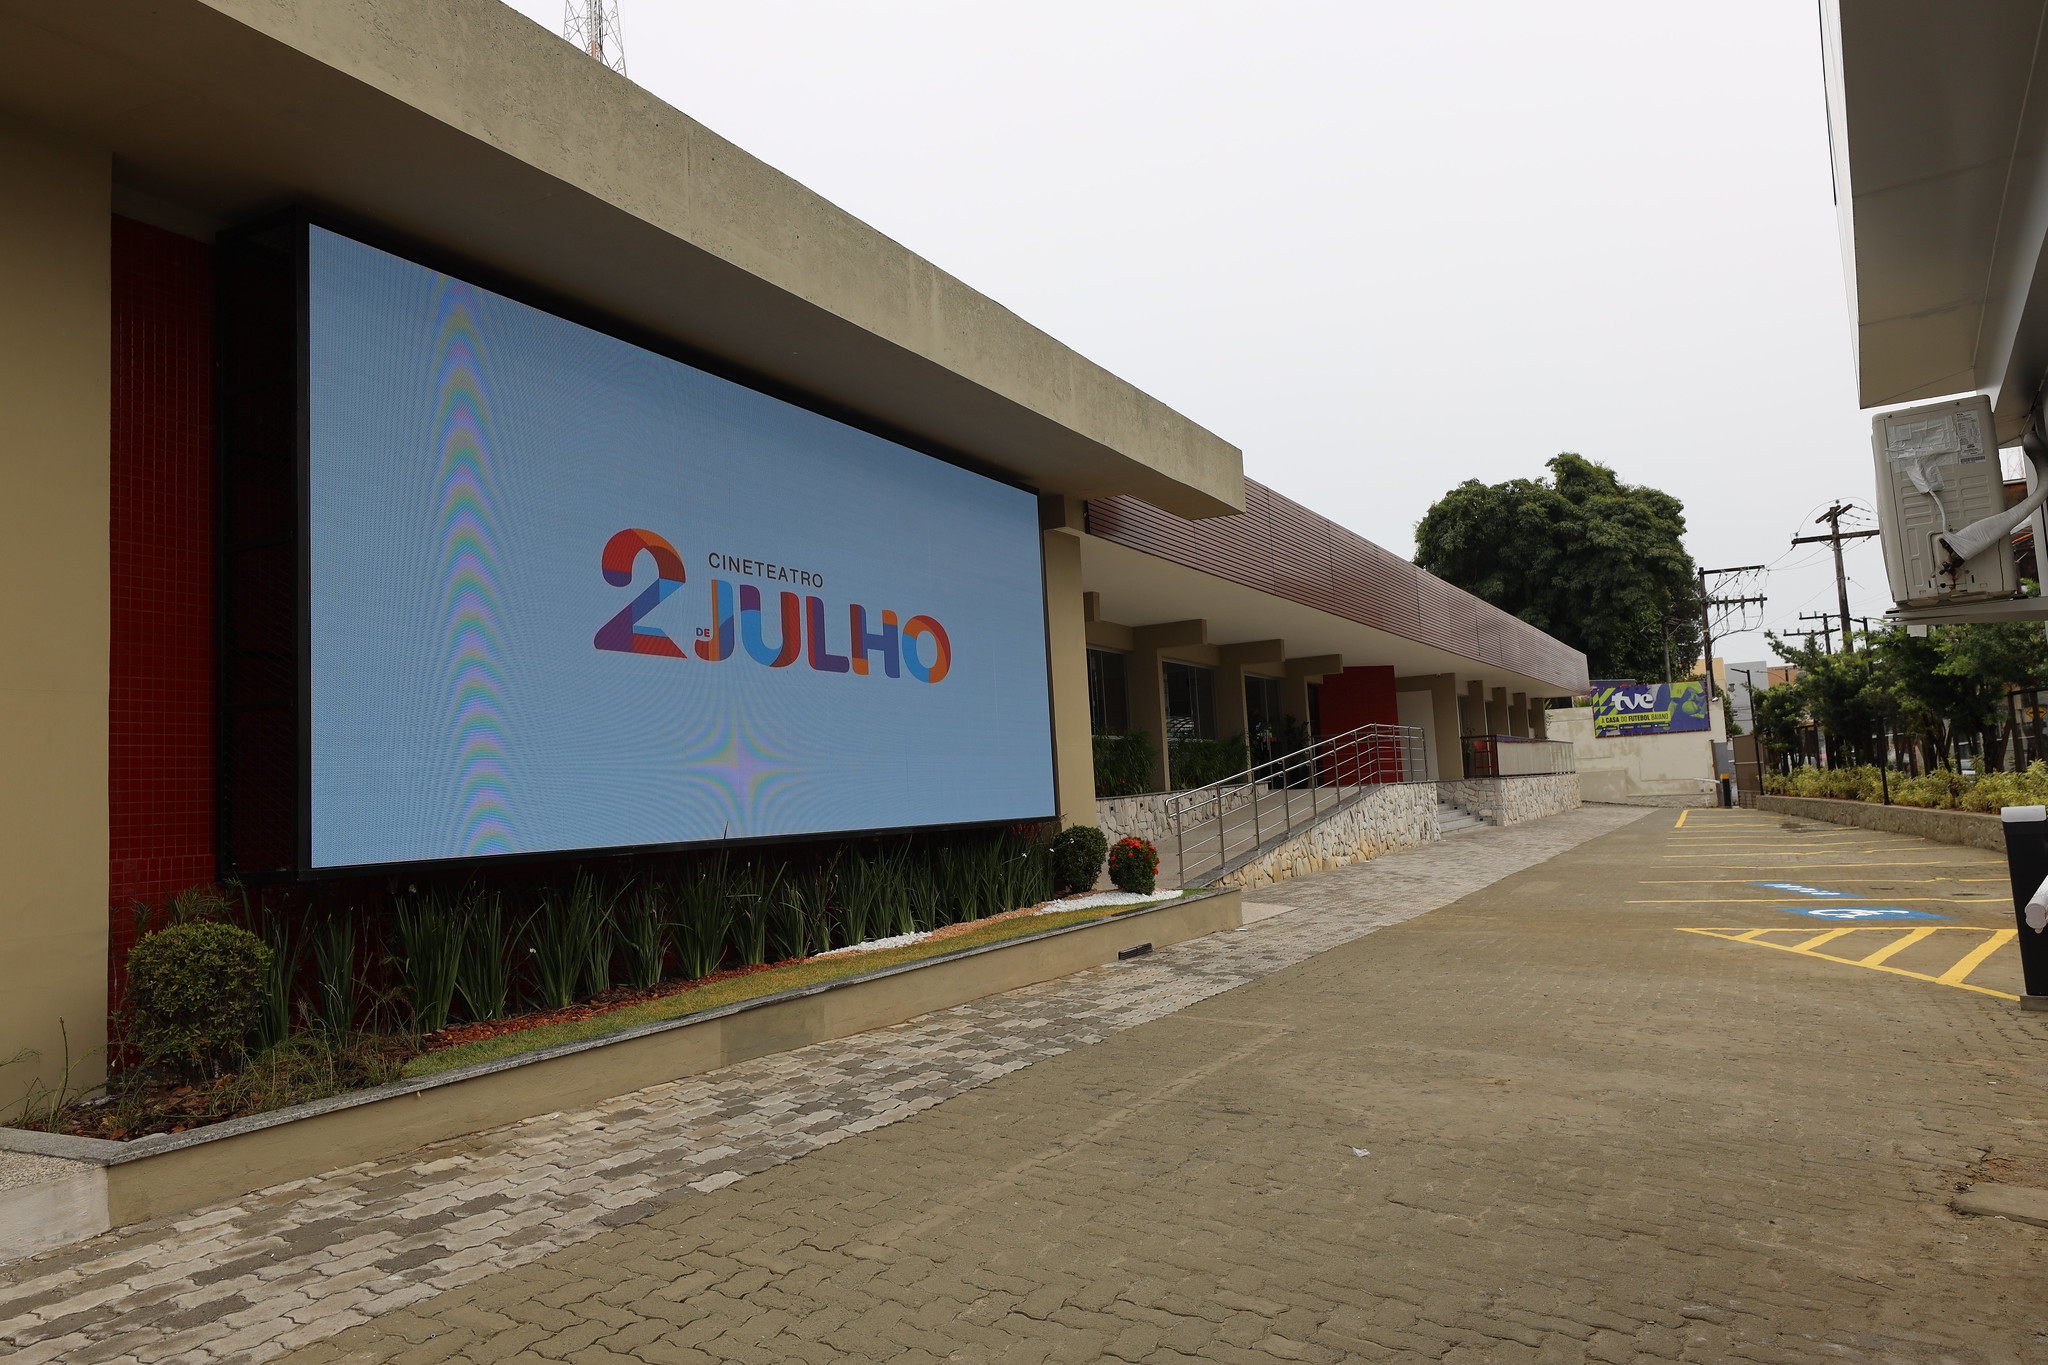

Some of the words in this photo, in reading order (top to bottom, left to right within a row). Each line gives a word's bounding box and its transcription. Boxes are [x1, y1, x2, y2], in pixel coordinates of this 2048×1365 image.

[708, 552, 824, 588] CINETEATRO
[593, 527, 688, 659] 2
[694, 579, 952, 684] JULHO
[695, 627, 711, 638] DE
[1612, 691, 1654, 711] tve
[1628, 714, 1650, 722] FUTEBOL
